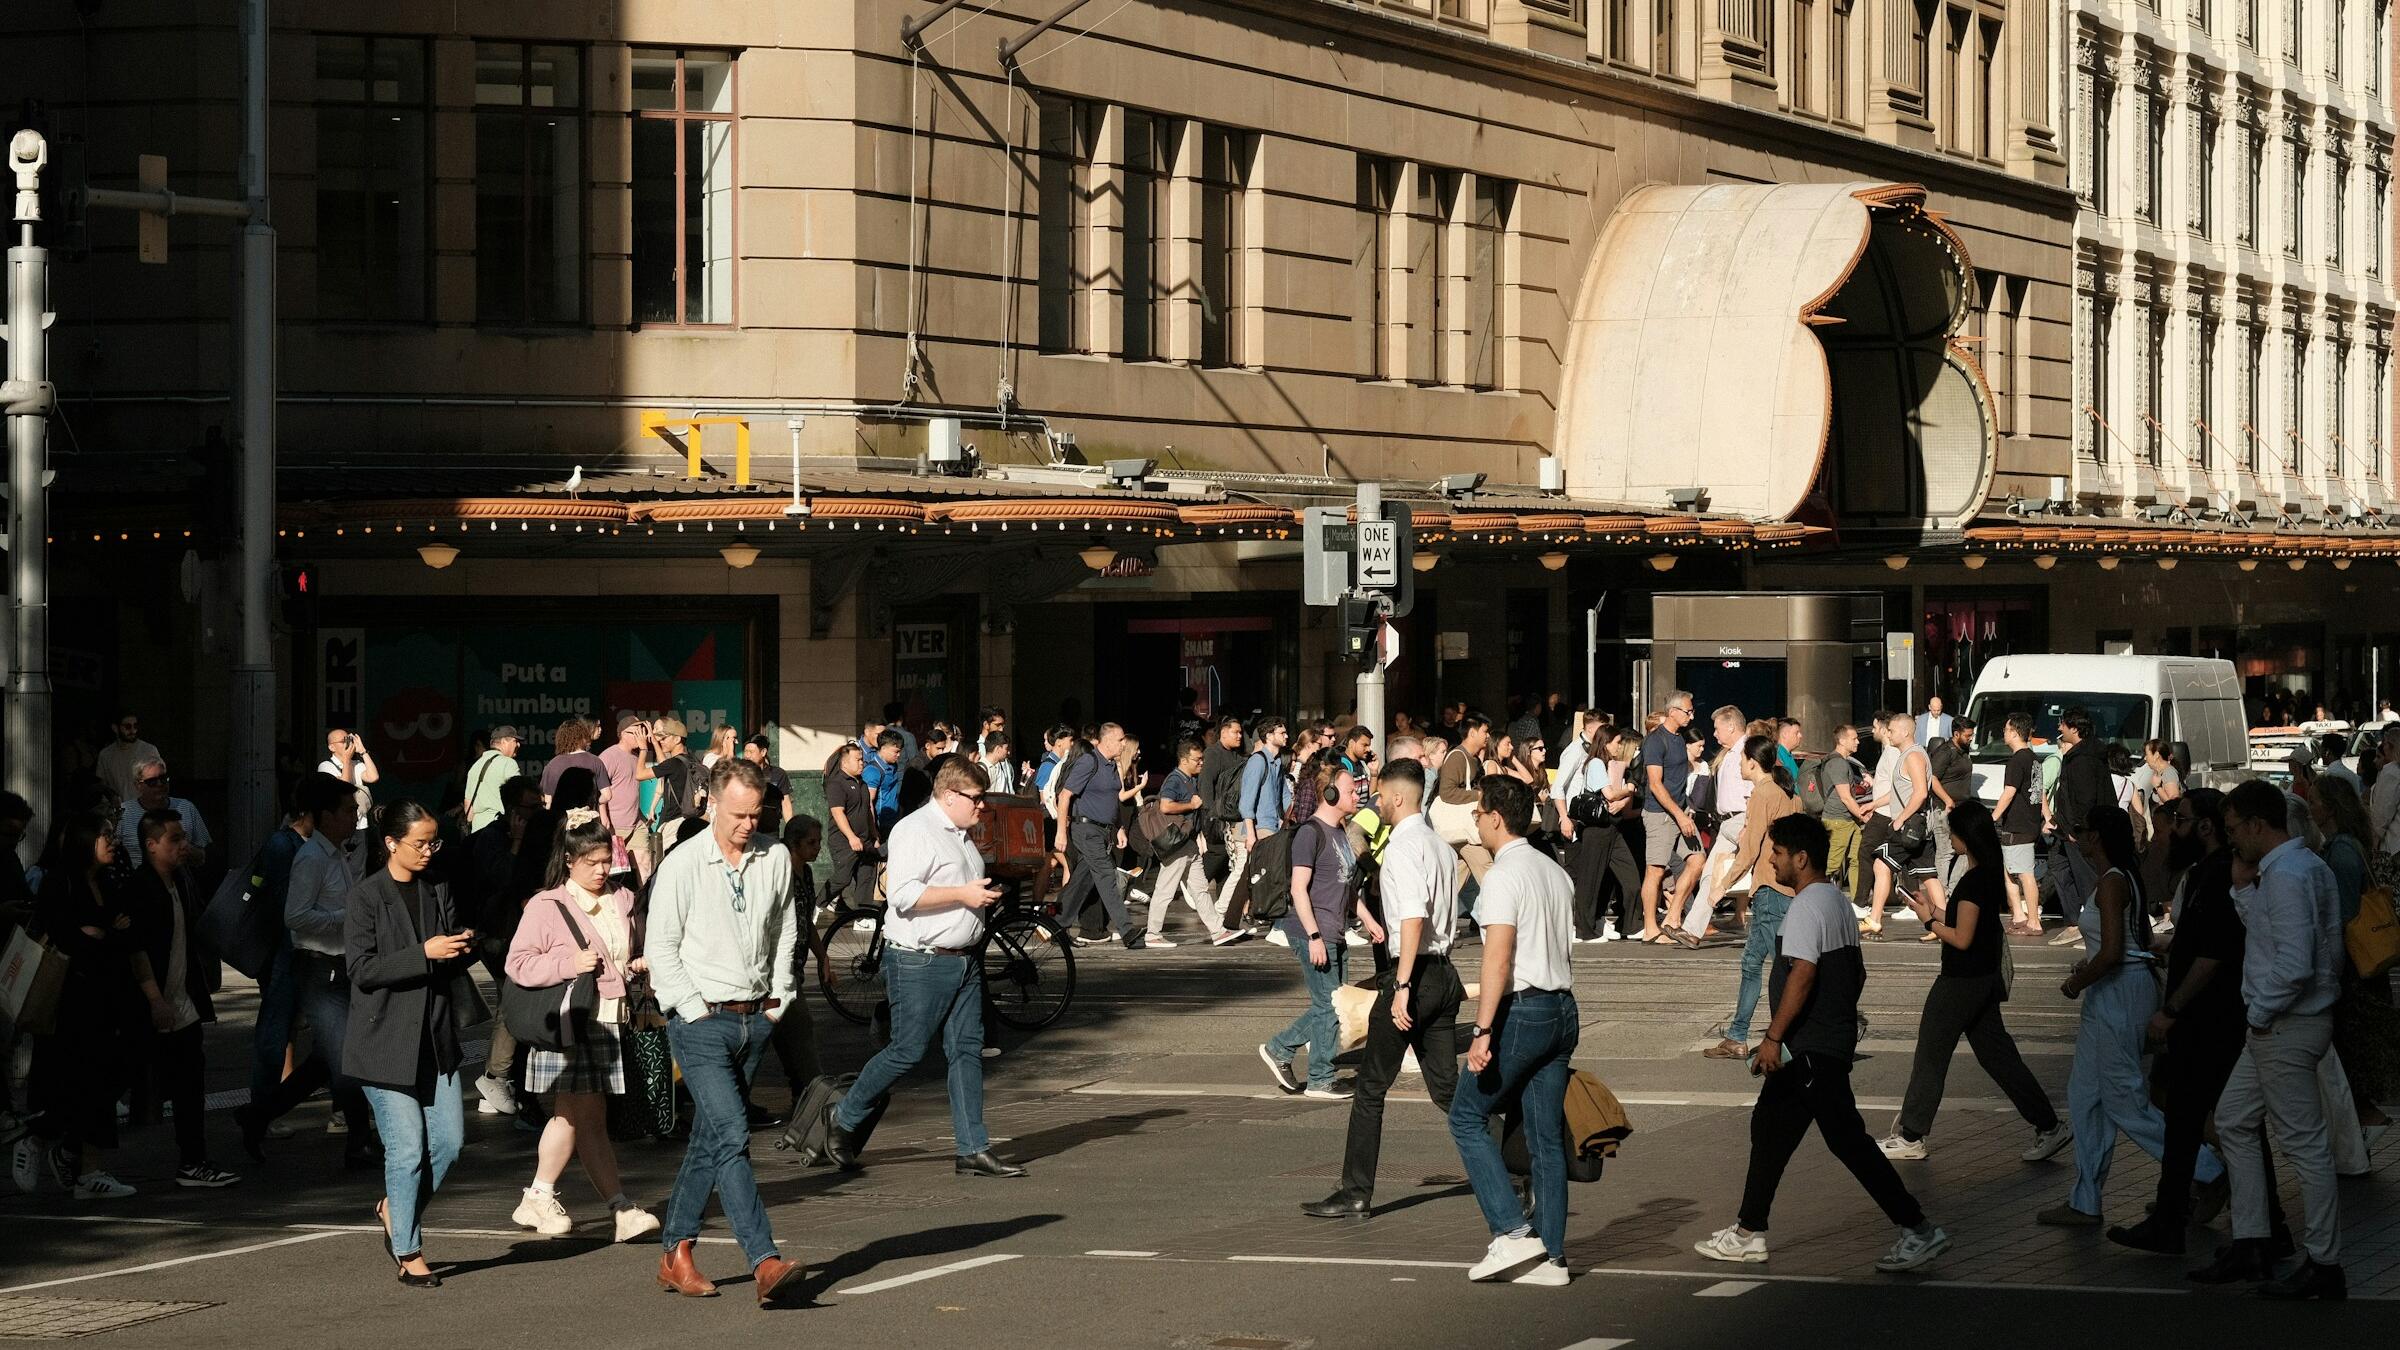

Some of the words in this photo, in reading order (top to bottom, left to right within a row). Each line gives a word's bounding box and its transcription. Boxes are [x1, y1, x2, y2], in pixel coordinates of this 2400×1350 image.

[1364, 527, 1389, 542] ONE
[1362, 547, 1391, 561] WAY
[1719, 646, 1742, 655] Kiosk
[501, 662, 546, 683] Put
[549, 665, 567, 683] a
[477, 693, 591, 716] humbug
